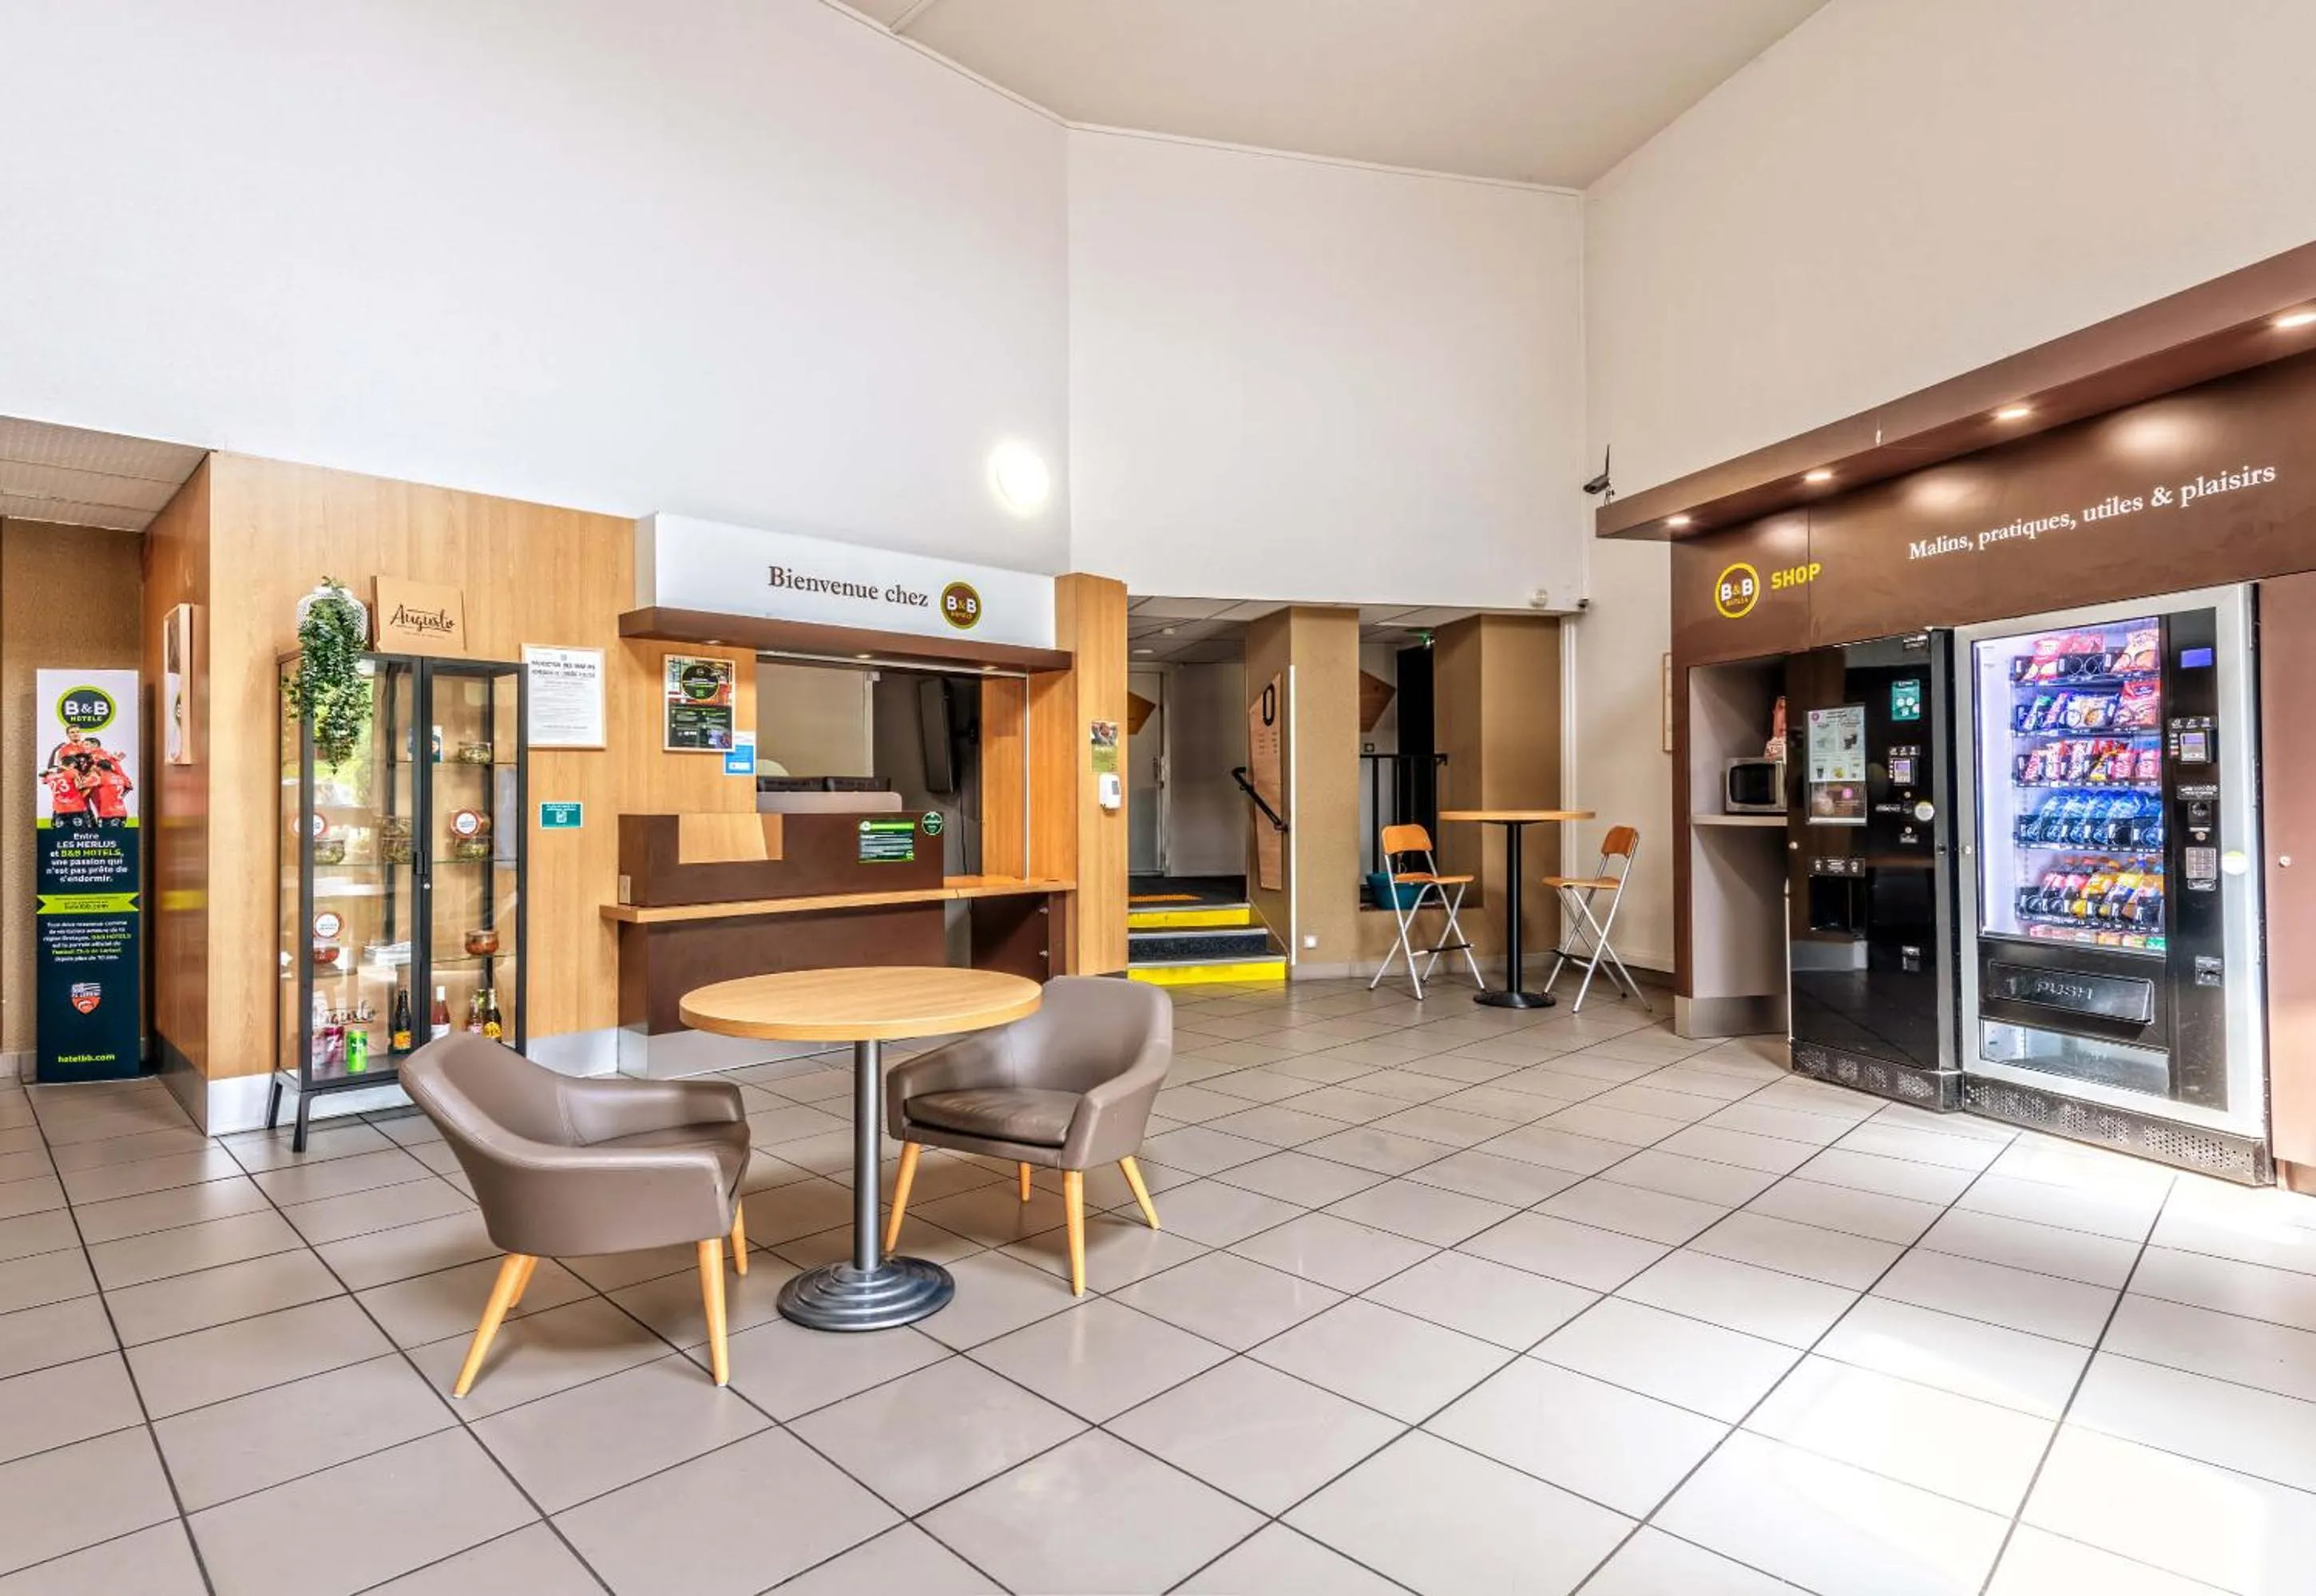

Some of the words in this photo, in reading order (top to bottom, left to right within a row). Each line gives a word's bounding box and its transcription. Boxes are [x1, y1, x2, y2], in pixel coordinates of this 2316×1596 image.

[1910, 535, 1973, 560] Malins,
[1978, 513, 2076, 551] pratiques,
[2083, 495, 2143, 522] utiles
[2151, 487, 2173, 507] &
[2179, 465, 2276, 509] plaisirs
[768, 565, 878, 599] Bienvenue
[885, 584, 929, 607] chez
[1771, 563, 1821, 589] SHOP
[1721, 578, 1754, 601] B&B
[946, 596, 977, 614] B&B
[390, 604, 456, 632] Augusto
[65, 700, 109, 715] B&B
[89, 866, 113, 875] prête
[2037, 980, 2093, 1000] PUSH
